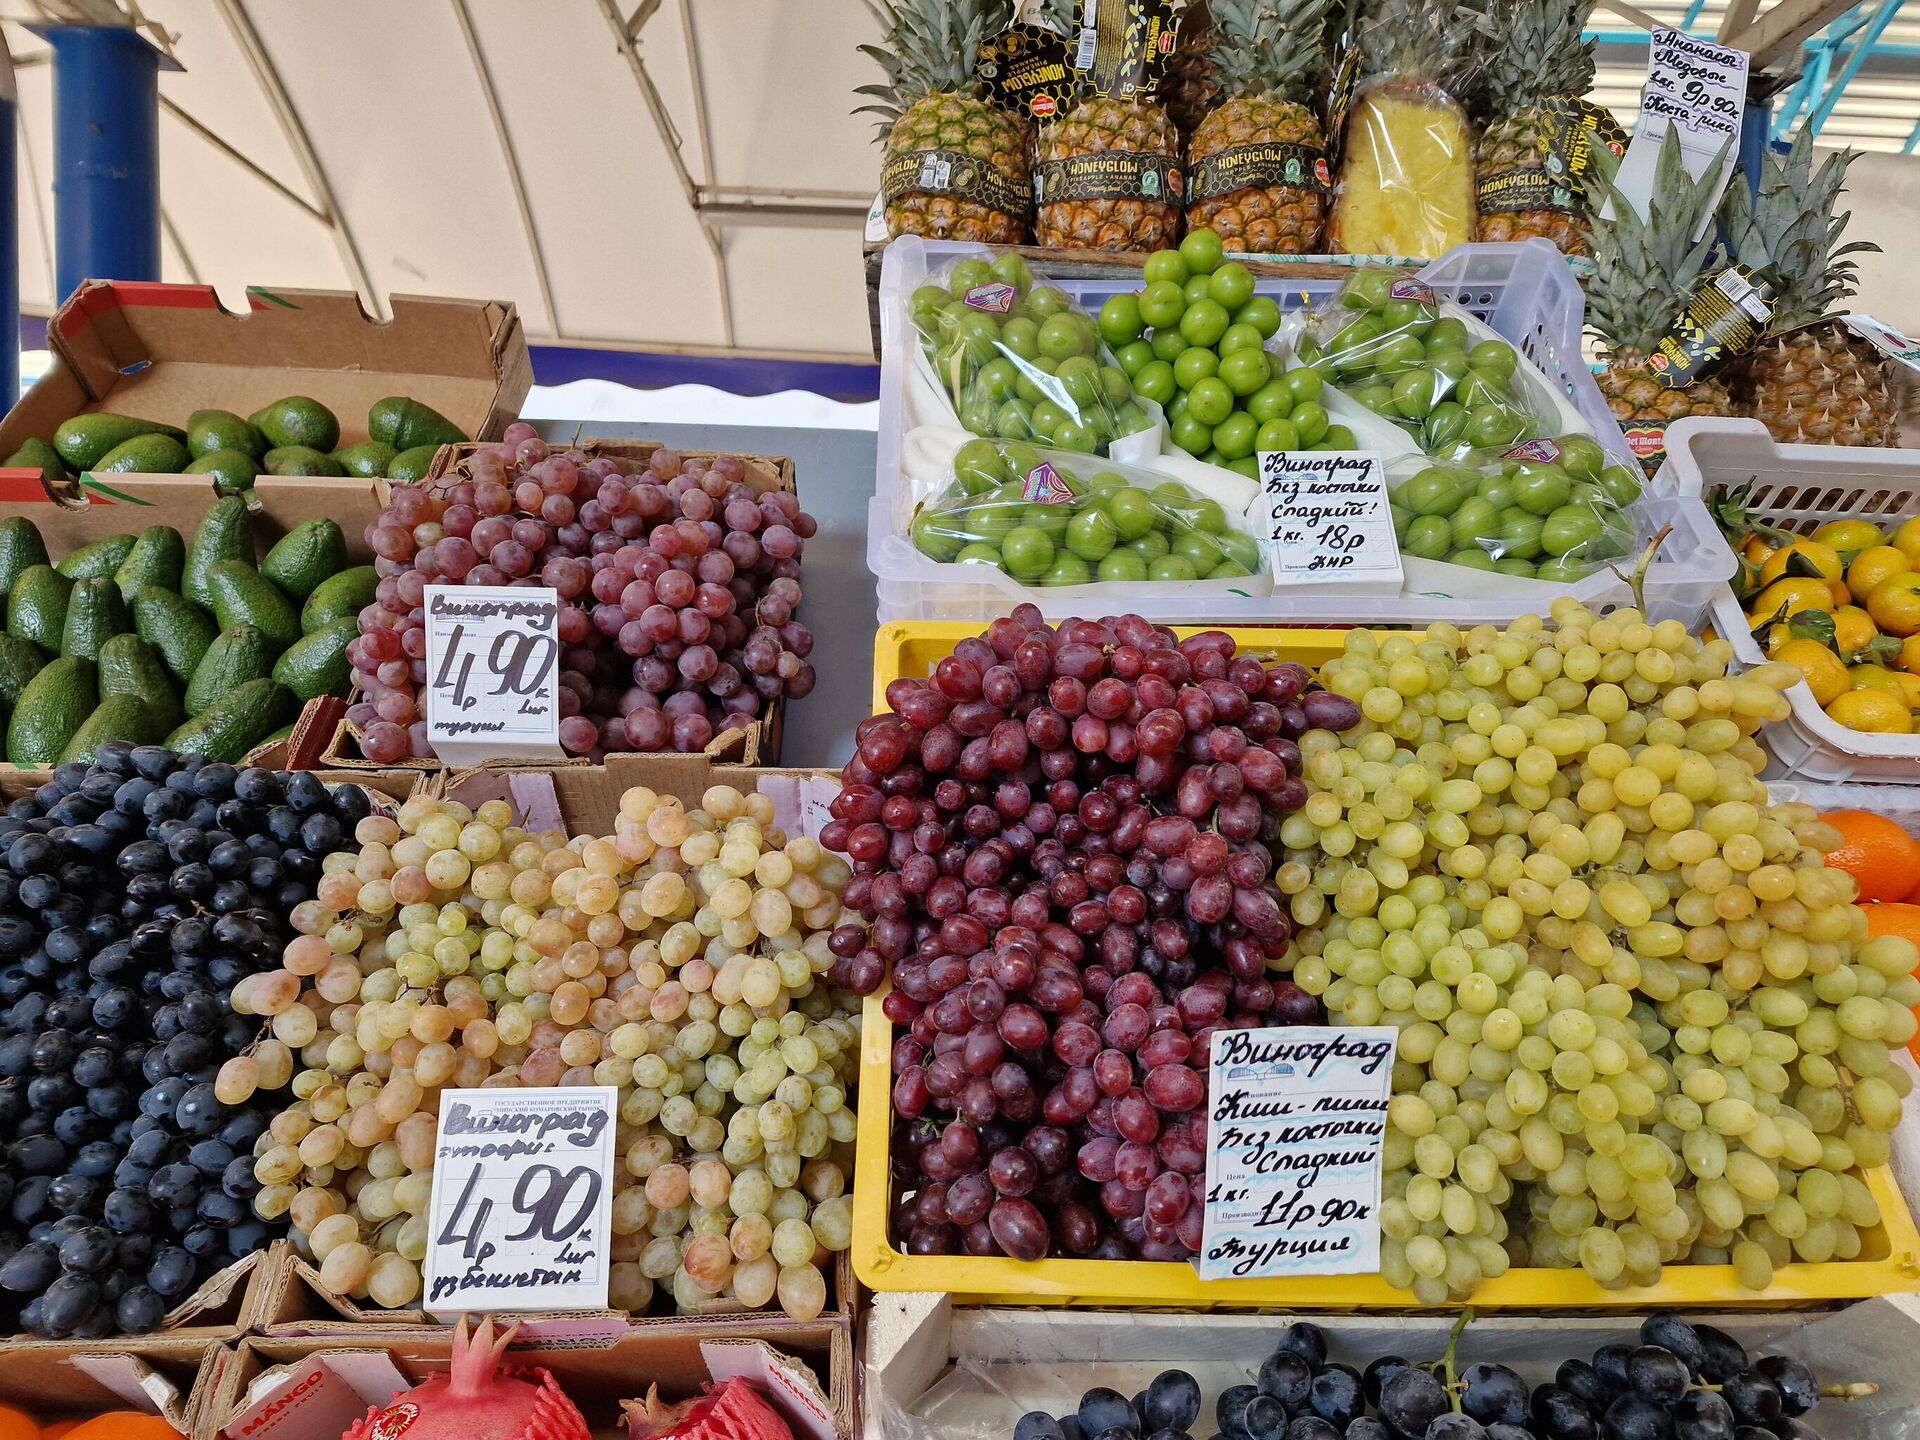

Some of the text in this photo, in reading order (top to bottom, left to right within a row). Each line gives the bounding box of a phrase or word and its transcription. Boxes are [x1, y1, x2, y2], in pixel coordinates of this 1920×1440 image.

[1653, 31, 1737, 67] Ананасы
[1654, 49, 1726, 82] Медовые
[1001, 64, 1066, 93] HONEYGLOW
[1070, 160, 1138, 175] HONEYGLOW
[1218, 149, 1281, 170] HONEYGLOW
[1480, 175, 1550, 195] HONEYGLOW
[1264, 452, 1373, 482] Виноград
[1266, 479, 1300, 504] Без
[1309, 555, 1354, 570] КНР
[430, 594, 557, 632] Виноград
[1214, 1031, 1391, 1078] Виноград
[443, 1102, 609, 1147] Виноград
[1217, 1120, 1384, 1165] Без косточки
[1256, 1142, 1379, 1188] Сладкий
[1208, 1236, 1350, 1275] Турция
